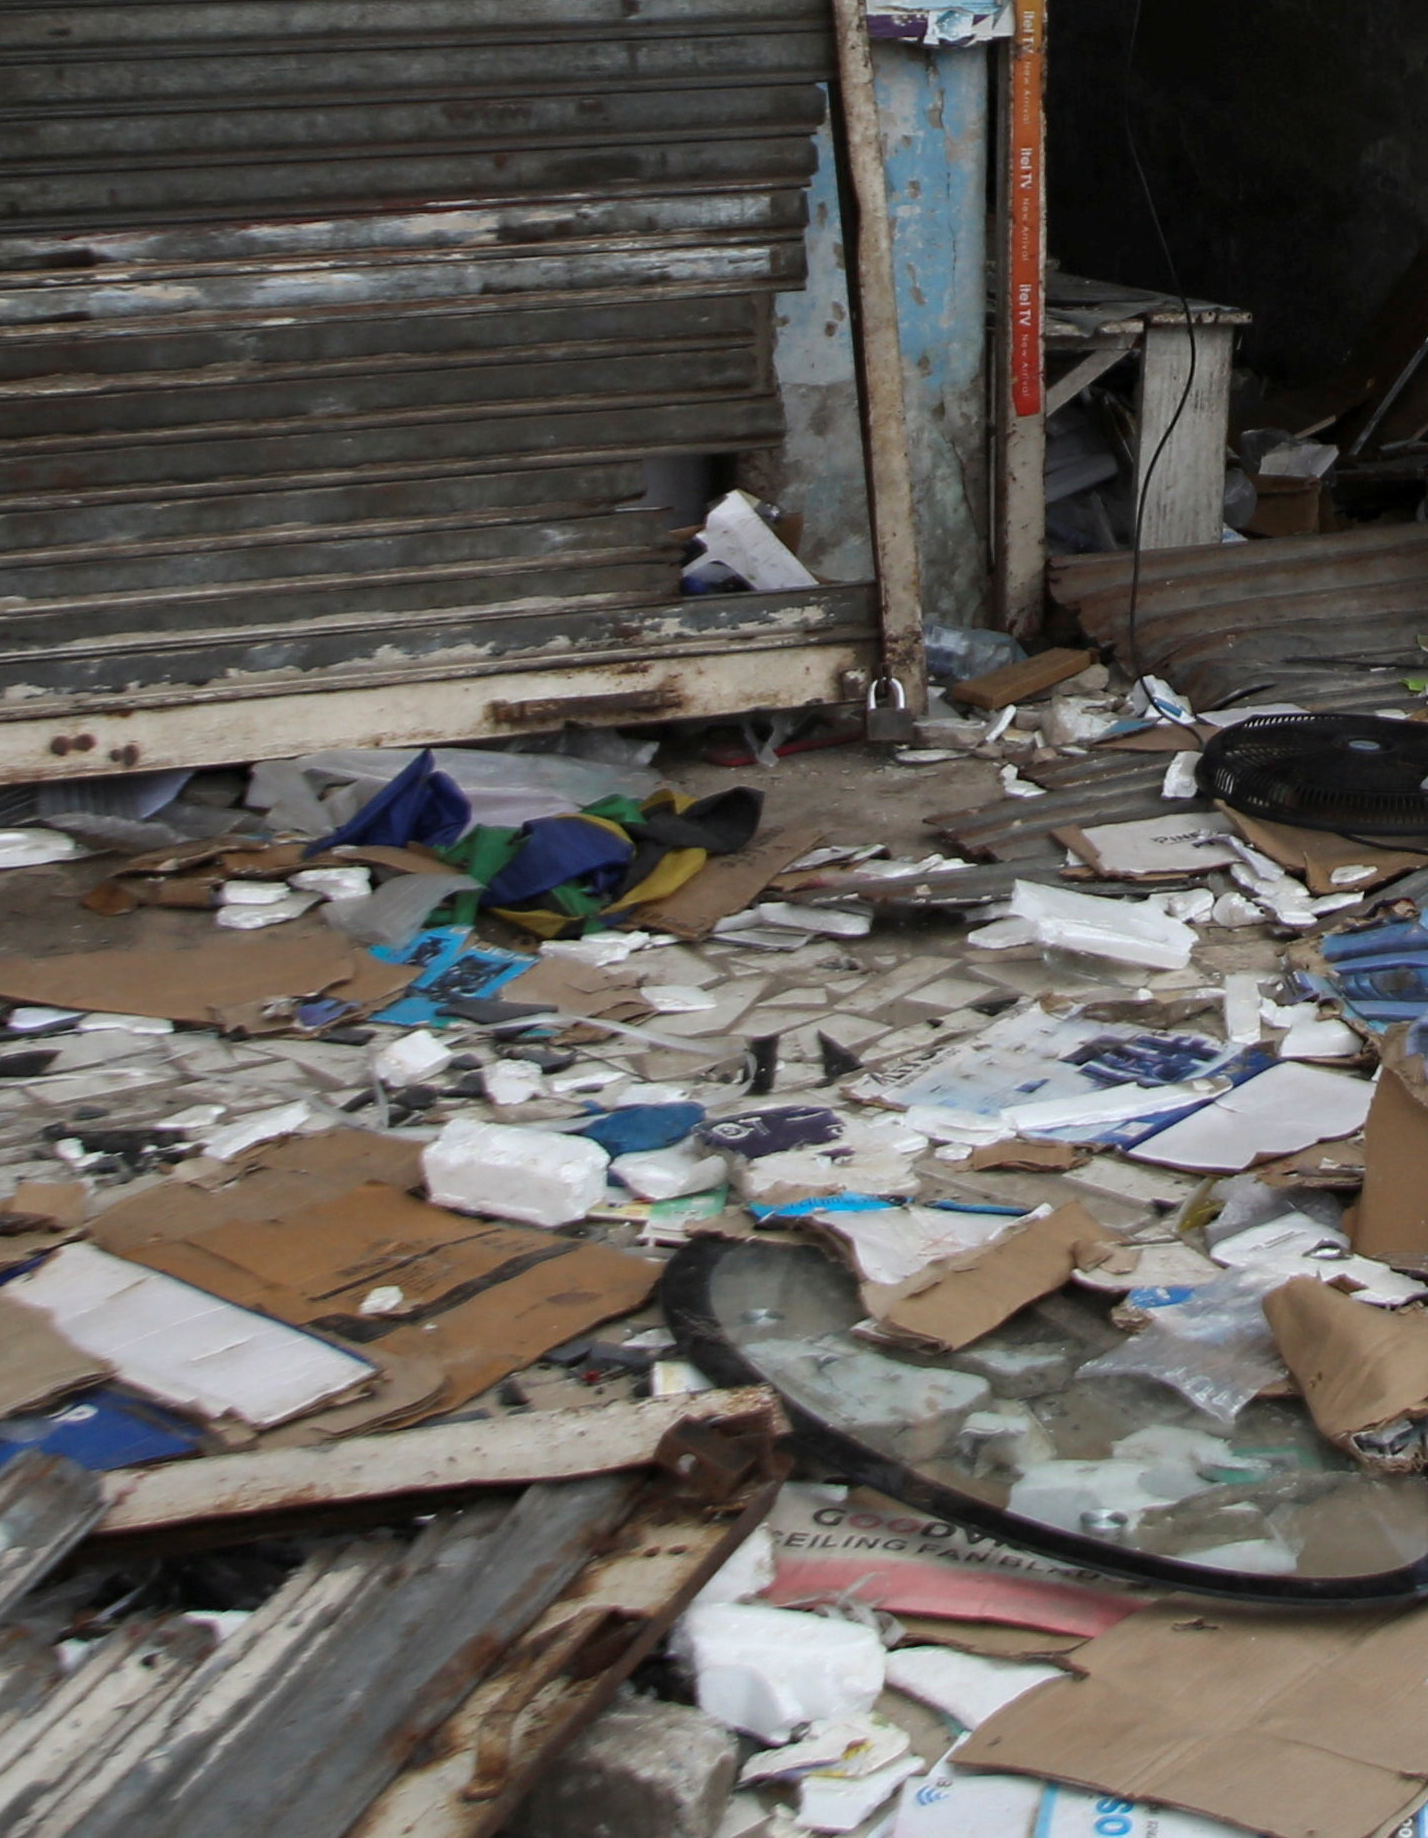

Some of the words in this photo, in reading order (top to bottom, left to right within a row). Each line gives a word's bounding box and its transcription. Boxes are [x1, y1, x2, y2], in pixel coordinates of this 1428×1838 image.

[1022, 11, 1036, 35] itel
[1021, 36, 1034, 54] TV
[1020, 148, 1033, 172] itel
[1019, 172, 1032, 190] TV
[1019, 284, 1032, 308] itel
[1018, 309, 1032, 327] TV
[917, 1542, 991, 1564] FAN
